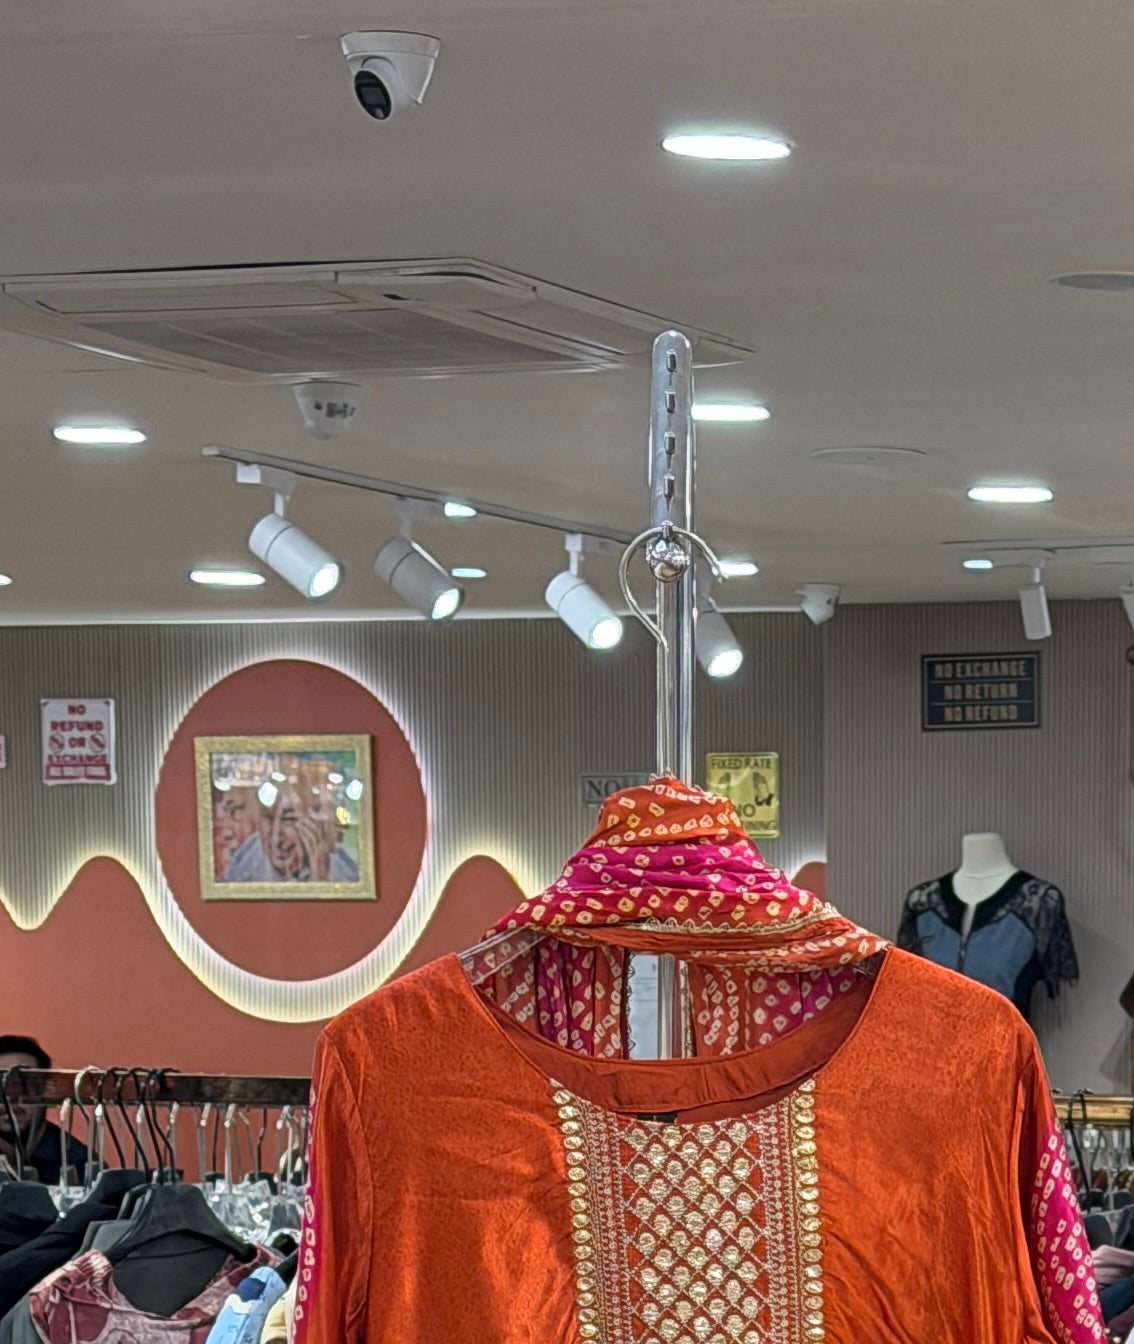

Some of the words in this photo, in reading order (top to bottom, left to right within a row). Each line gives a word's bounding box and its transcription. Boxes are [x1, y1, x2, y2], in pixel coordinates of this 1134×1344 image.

[934, 662, 953, 678] NO
[956, 660, 1028, 678] EXCHANGE
[944, 684, 962, 700] NO
[965, 682, 1018, 699] RETURN
[67, 704, 87, 715] NO
[944, 705, 963, 721] NO
[965, 704, 1018, 720] REFUND
[50, 720, 104, 731] REFUND
[68, 736, 87, 748] OR
[48, 754, 107, 765] EXCHANGE
[710, 758, 742, 770] FIXED
[744, 758, 772, 769] RATE
